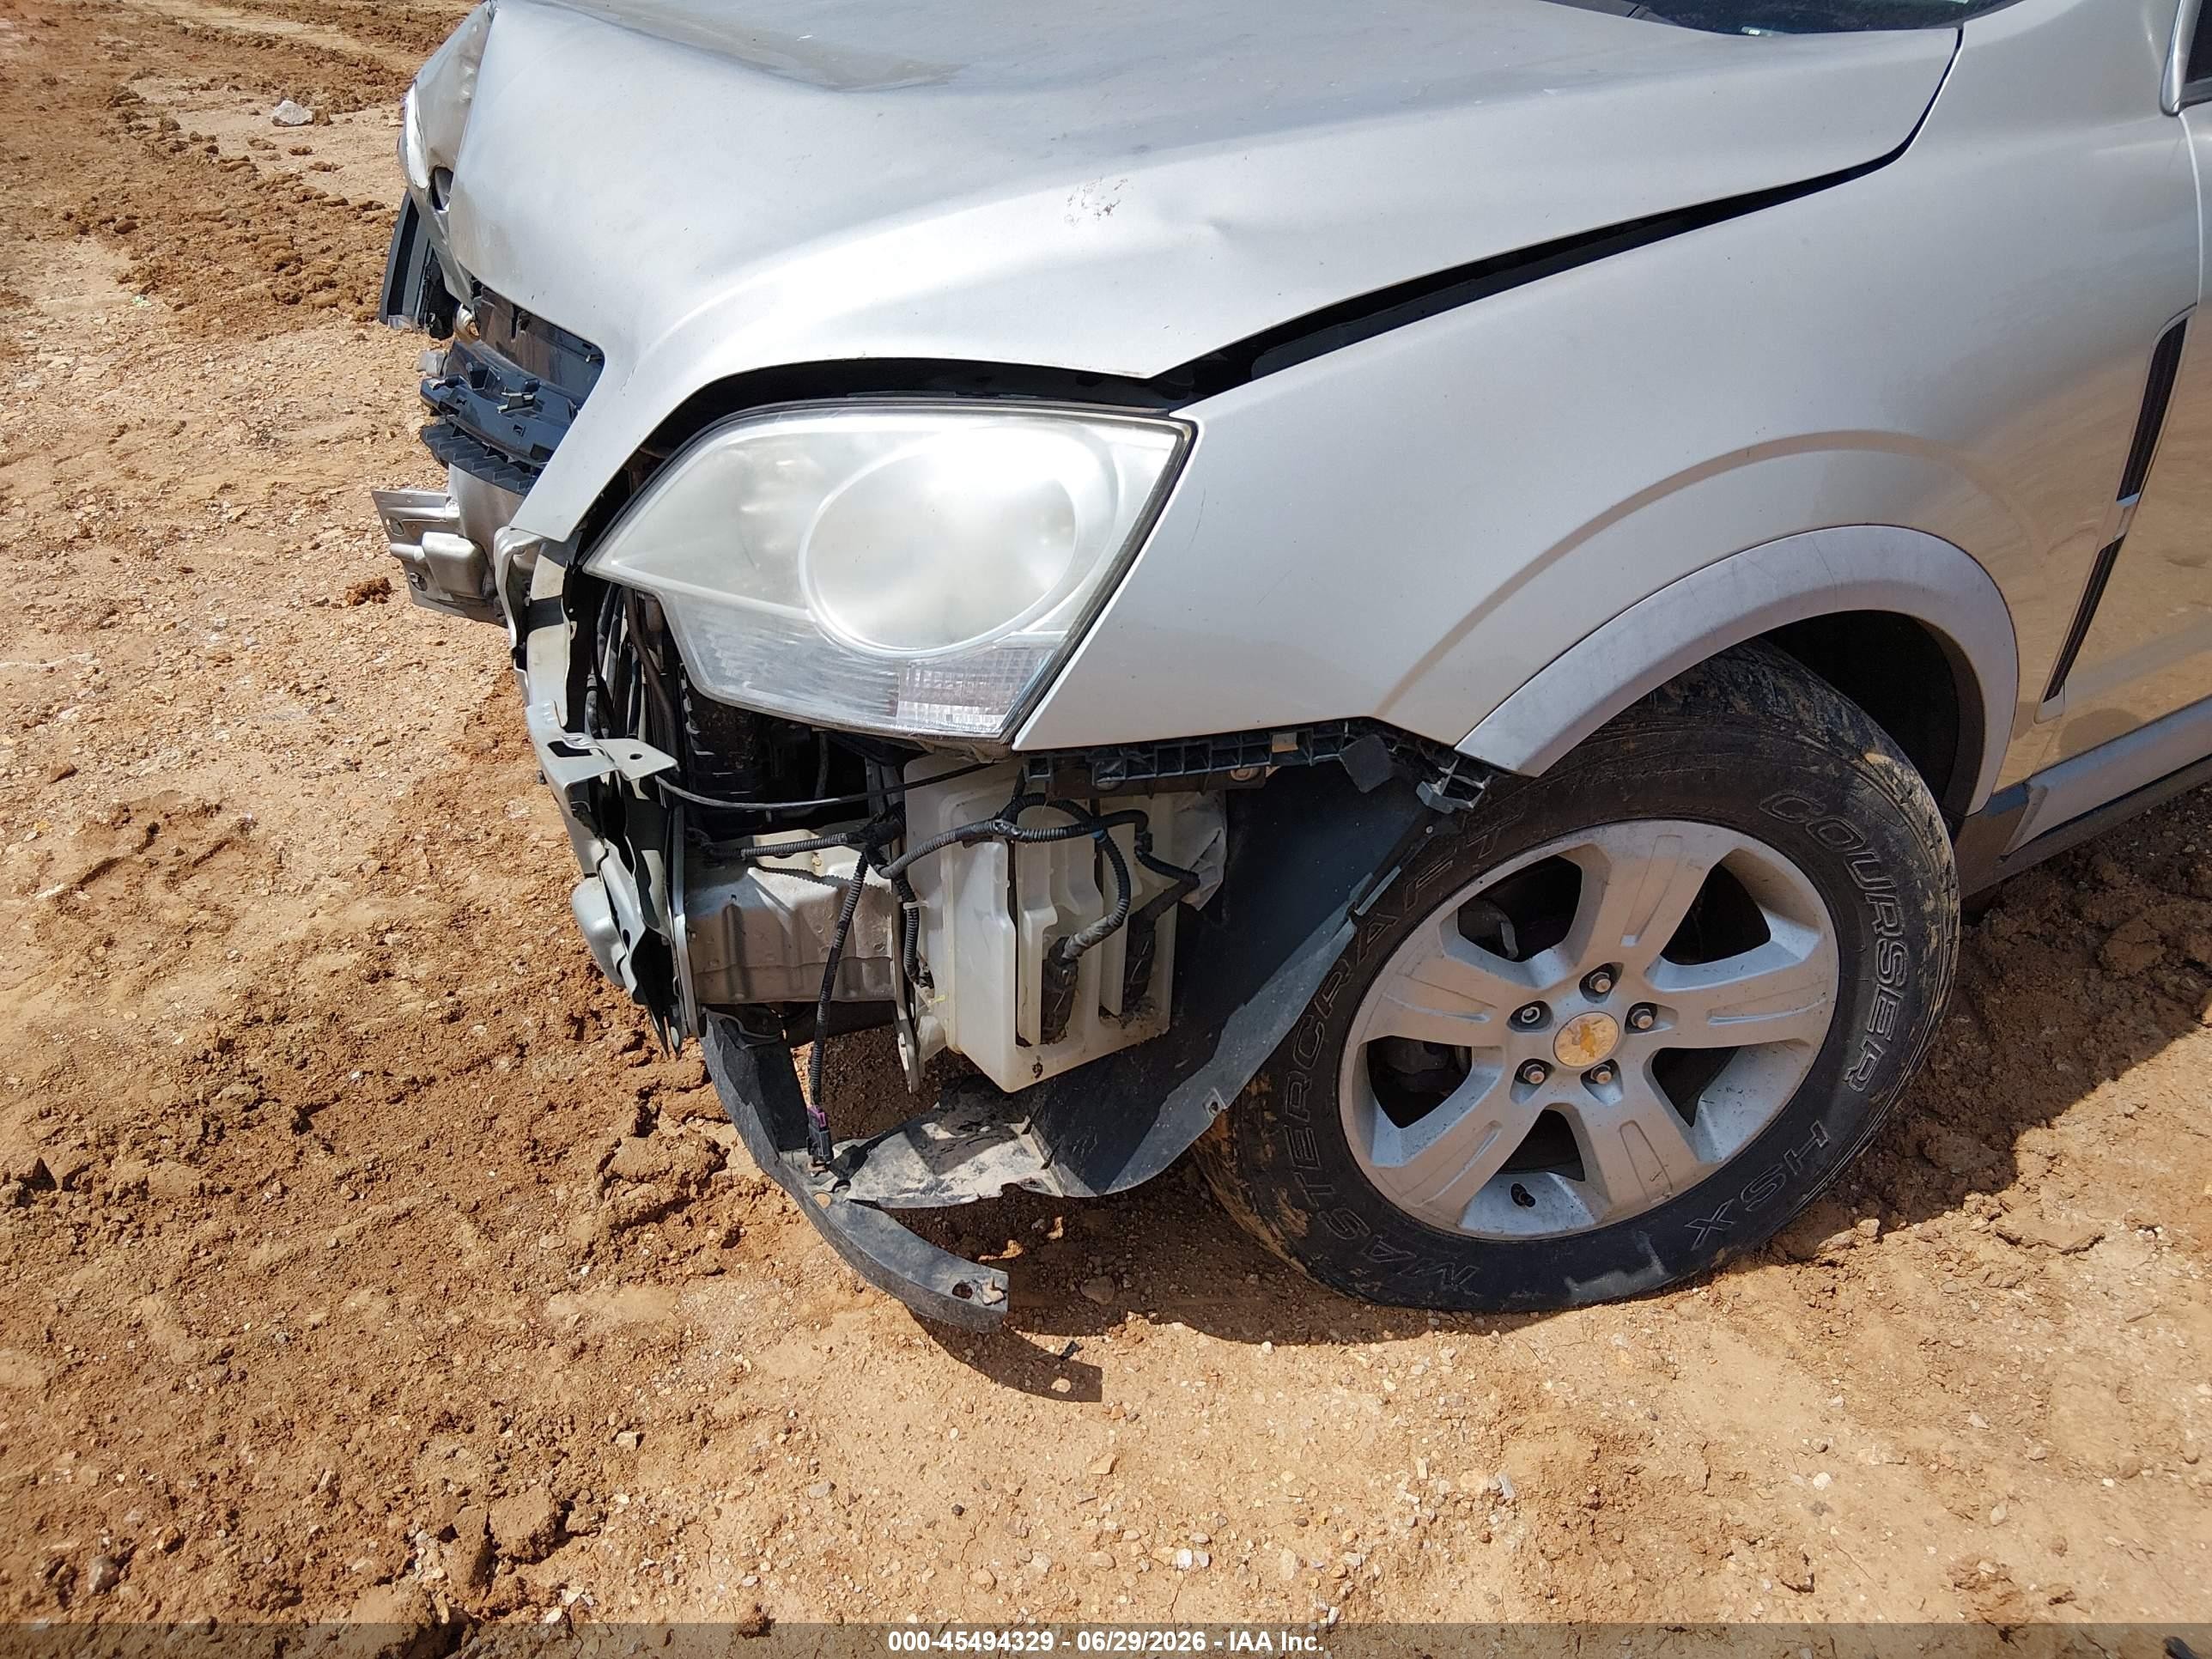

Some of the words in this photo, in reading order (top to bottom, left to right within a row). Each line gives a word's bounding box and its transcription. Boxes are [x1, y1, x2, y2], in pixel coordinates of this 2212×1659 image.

[1284, 810, 1526, 1298] MASTERCRAFT
[1758, 789, 1904, 1094] COURSER
[1684, 1119, 1832, 1251] HSX
